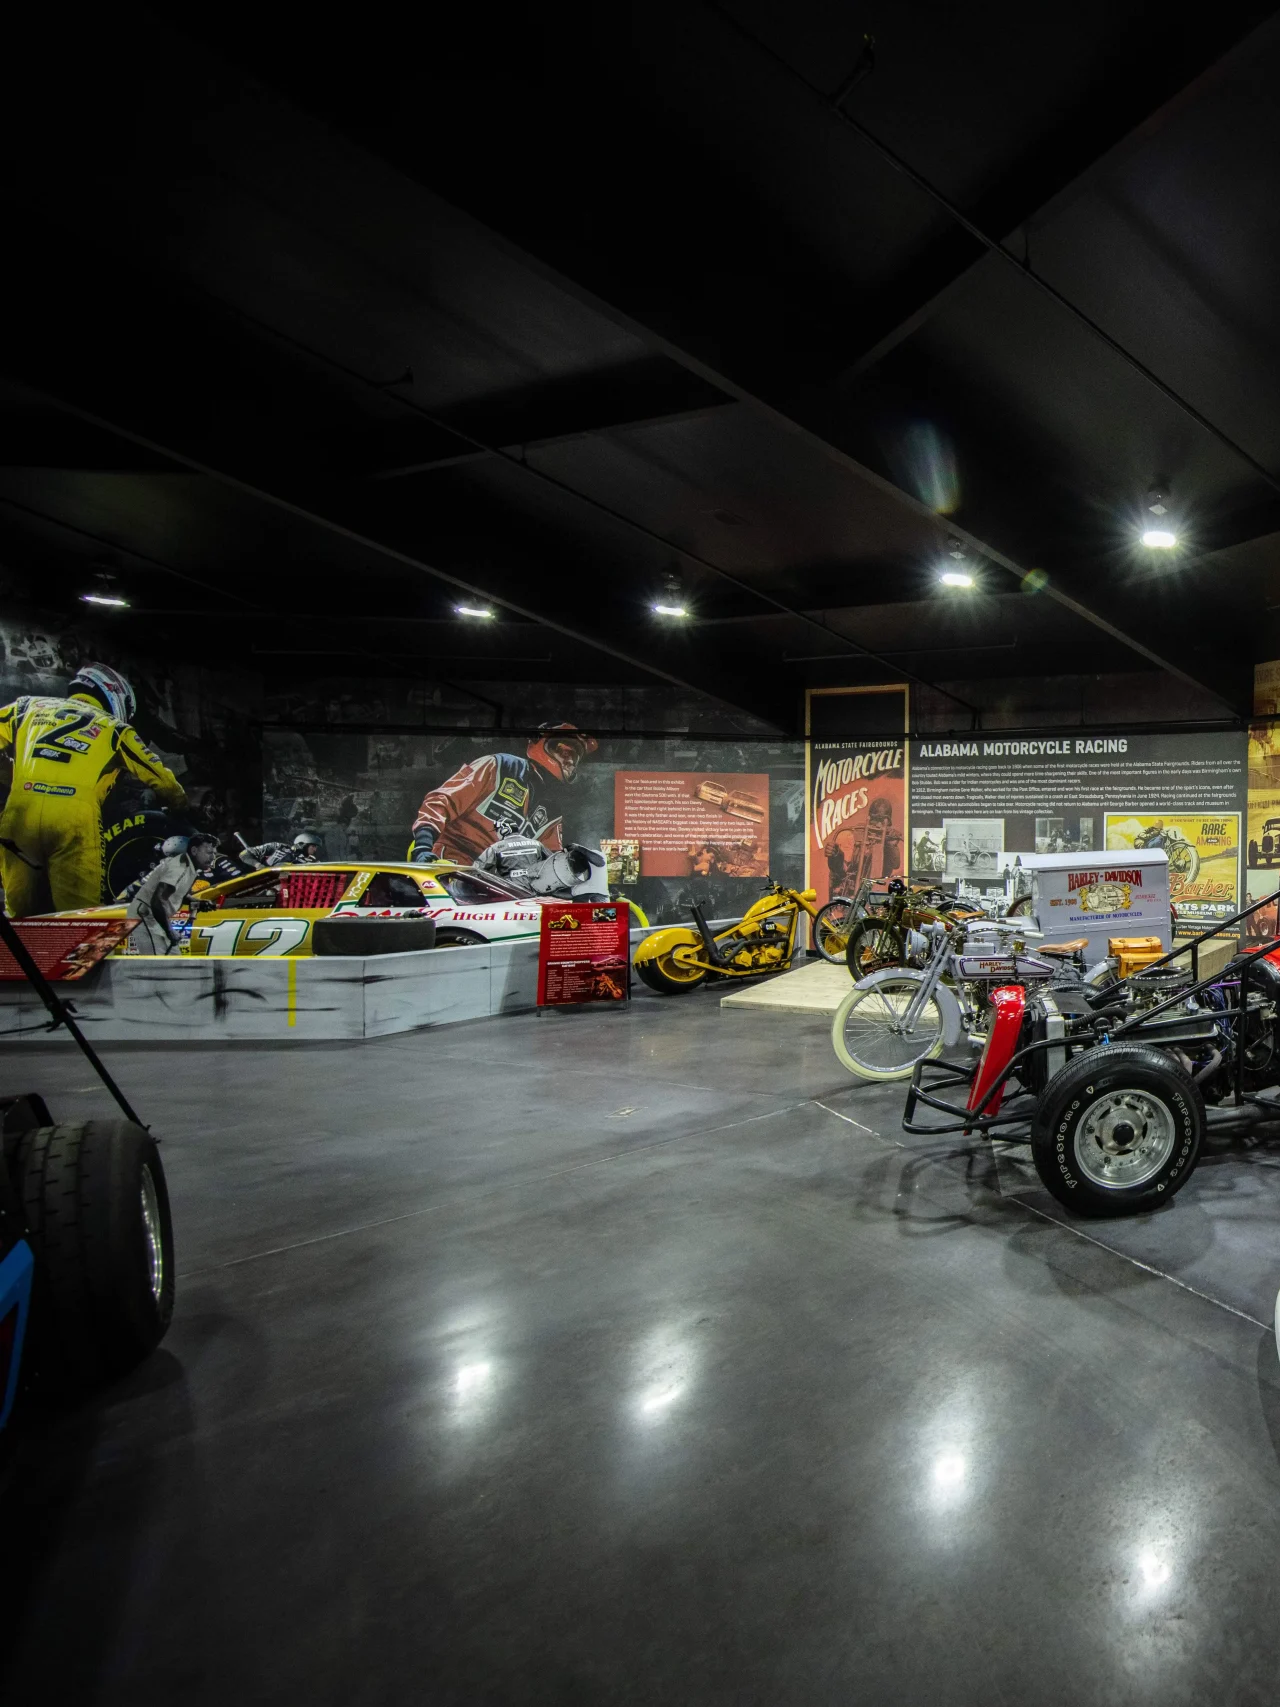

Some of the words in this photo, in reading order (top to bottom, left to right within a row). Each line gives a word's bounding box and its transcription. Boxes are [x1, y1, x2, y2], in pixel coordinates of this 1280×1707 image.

[814, 742, 840, 750] ALABAMA
[920, 743, 979, 757] ALABAMA
[984, 741, 1071, 756] MOTORCYCLE
[1075, 739, 1128, 754] RACING
[814, 749, 903, 801] MOTORCYCLE
[821, 787, 868, 841] RACES
[1201, 823, 1227, 836] RARE
[1169, 873, 1235, 897] Barber
[1201, 903, 1235, 912] PARK
[452, 911, 496, 921] HIGH
[503, 911, 538, 921] LIFE
[1069, 914, 1105, 922] MANUFACTURER
[1112, 911, 1143, 919] MOTORCYCLES
[198, 919, 310, 957] 12
[979, 961, 1004, 969] HARLEY-
[990, 965, 1016, 973] DAVIDSO
[1171, 1092, 1192, 1178] Firestone
[1056, 1100, 1081, 1189] Firestone
